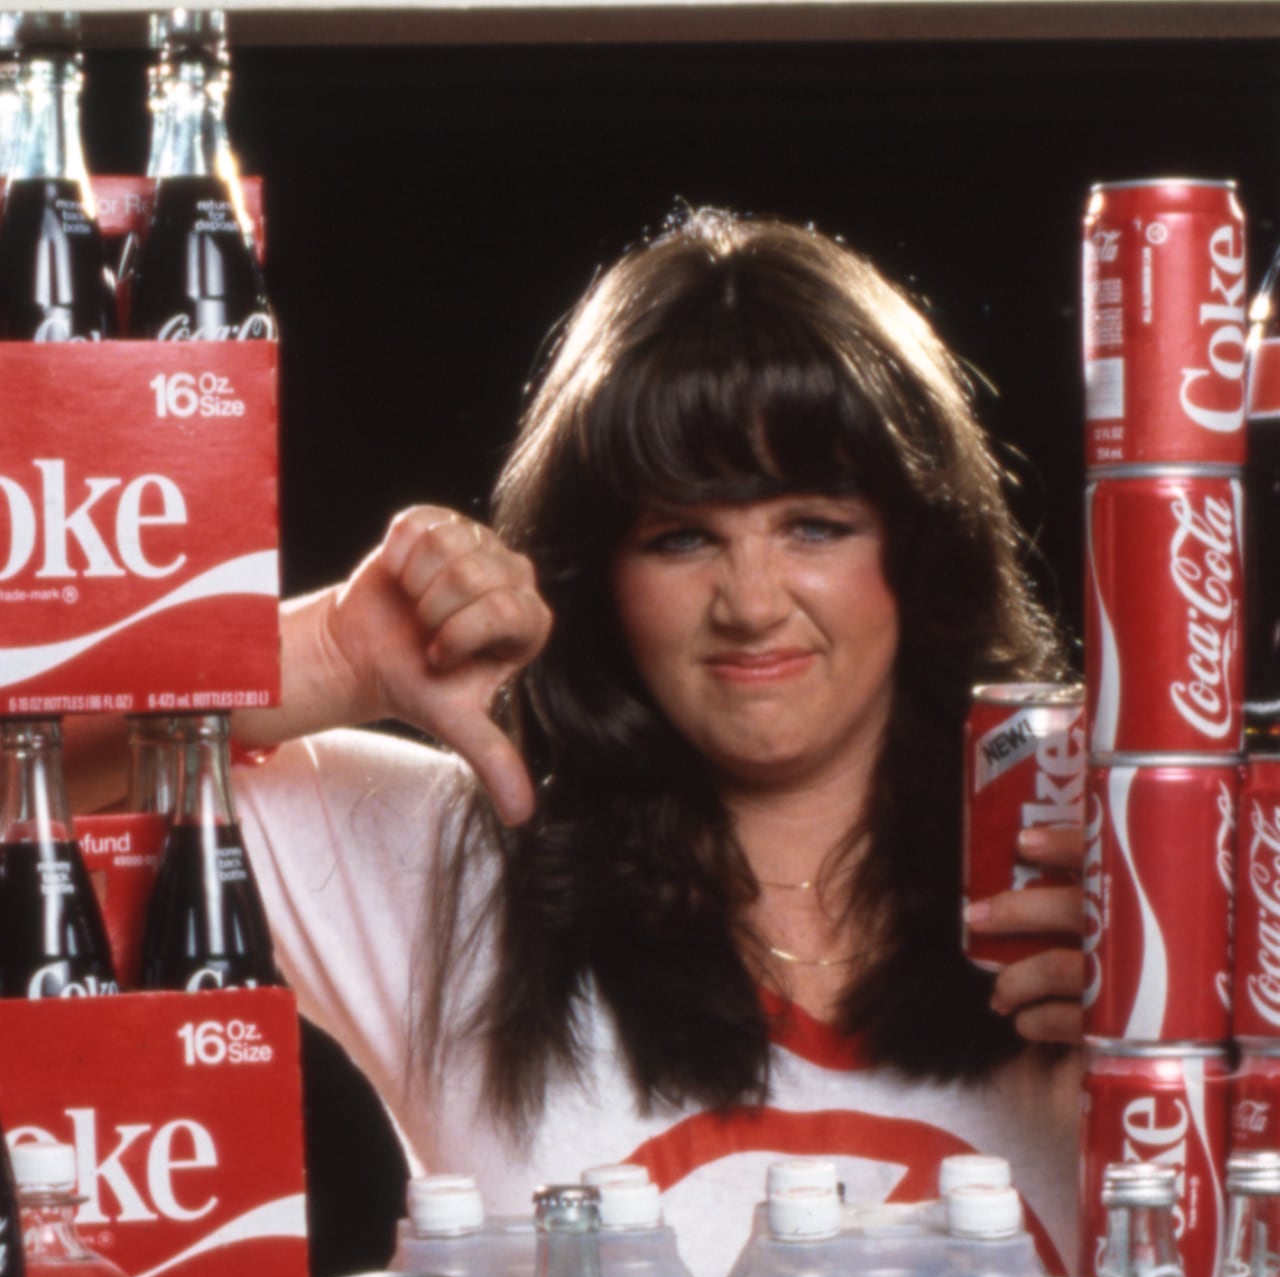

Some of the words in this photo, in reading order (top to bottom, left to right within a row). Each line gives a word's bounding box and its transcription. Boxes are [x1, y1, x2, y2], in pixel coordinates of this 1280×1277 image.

[1179, 226, 1245, 432] Coke
[150, 372, 197, 419] 16
[199, 373, 234, 395] Oz.
[199, 396, 244, 417] Size
[981, 718, 1034, 767] NEW!
[178, 1021, 226, 1066] 16
[227, 1021, 262, 1042] Oz.
[227, 1043, 272, 1063] Size
[7, 1108, 218, 1224] ke
